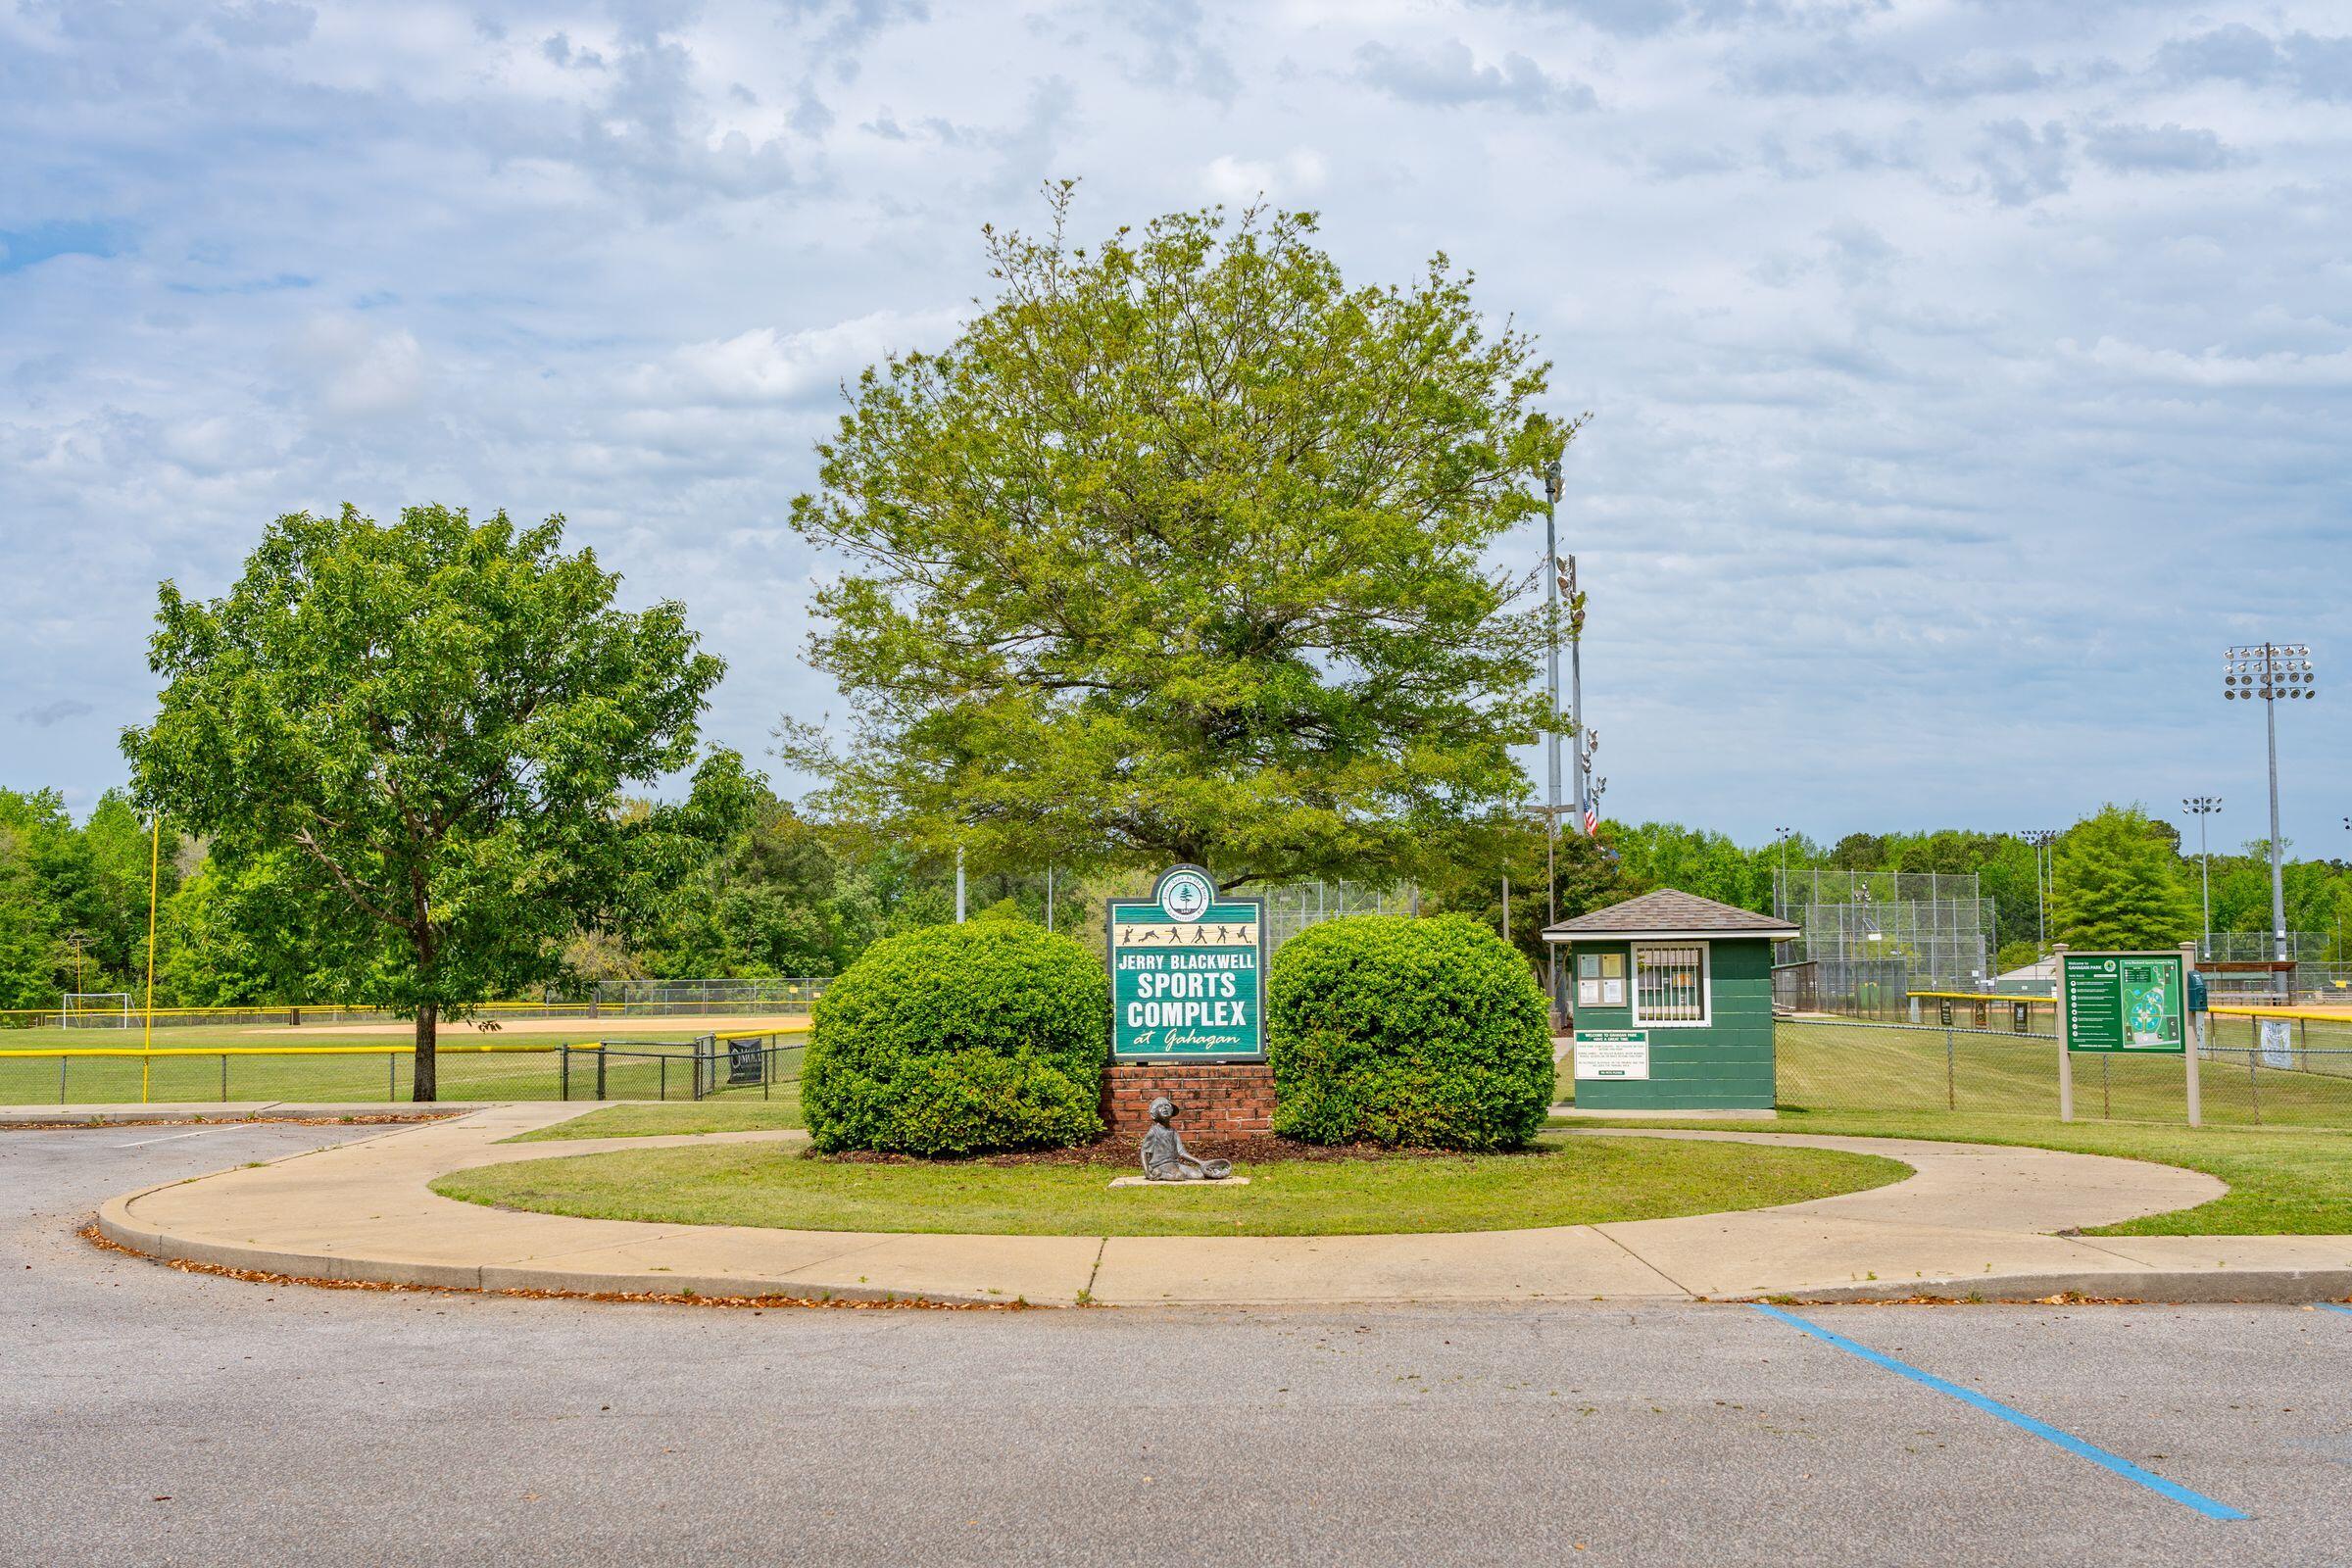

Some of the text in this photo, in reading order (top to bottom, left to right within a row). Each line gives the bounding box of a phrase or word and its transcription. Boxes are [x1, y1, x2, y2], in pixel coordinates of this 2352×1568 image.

[1119, 955, 1254, 970] JERRY BLACKWELL
[1138, 973, 1236, 998] SPORTS
[1128, 1002, 1246, 1027] COMPLEX
[1133, 1029, 1240, 1051] at Gahagan
